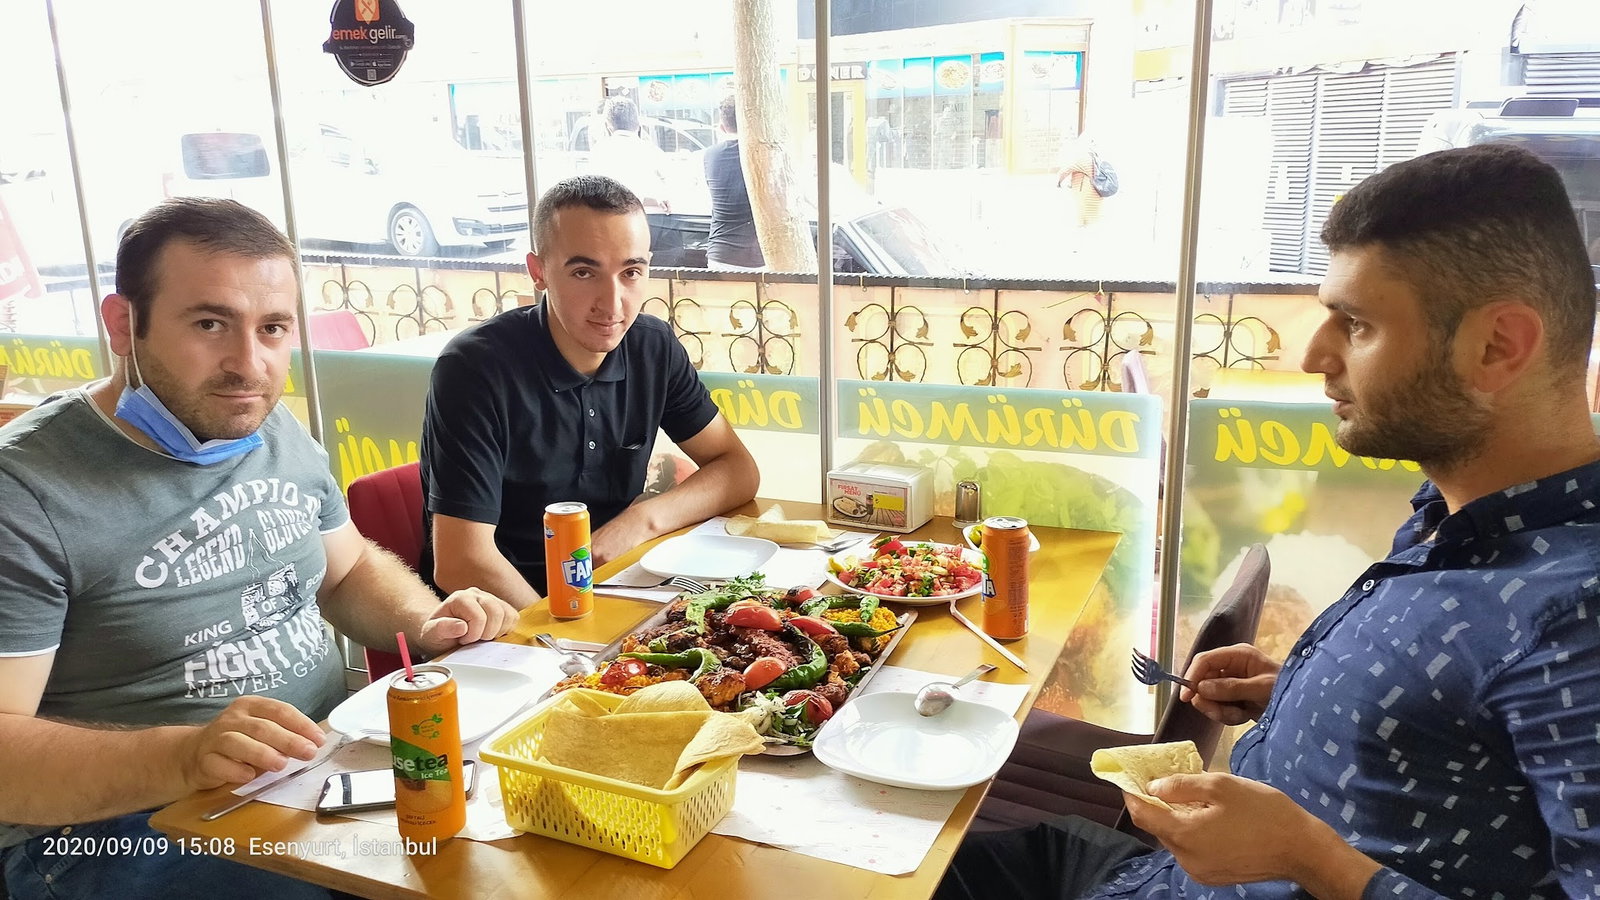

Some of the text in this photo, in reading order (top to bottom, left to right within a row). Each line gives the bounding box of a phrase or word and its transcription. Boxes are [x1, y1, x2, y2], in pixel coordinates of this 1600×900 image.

[332, 26, 369, 40] emek
[798, 64, 865, 81] DNER
[174, 523, 246, 588] LEGEND
[185, 620, 233, 646] KING
[261, 598, 278, 613] OF
[184, 628, 291, 682] FIGHT
[184, 671, 287, 698] NEVER
